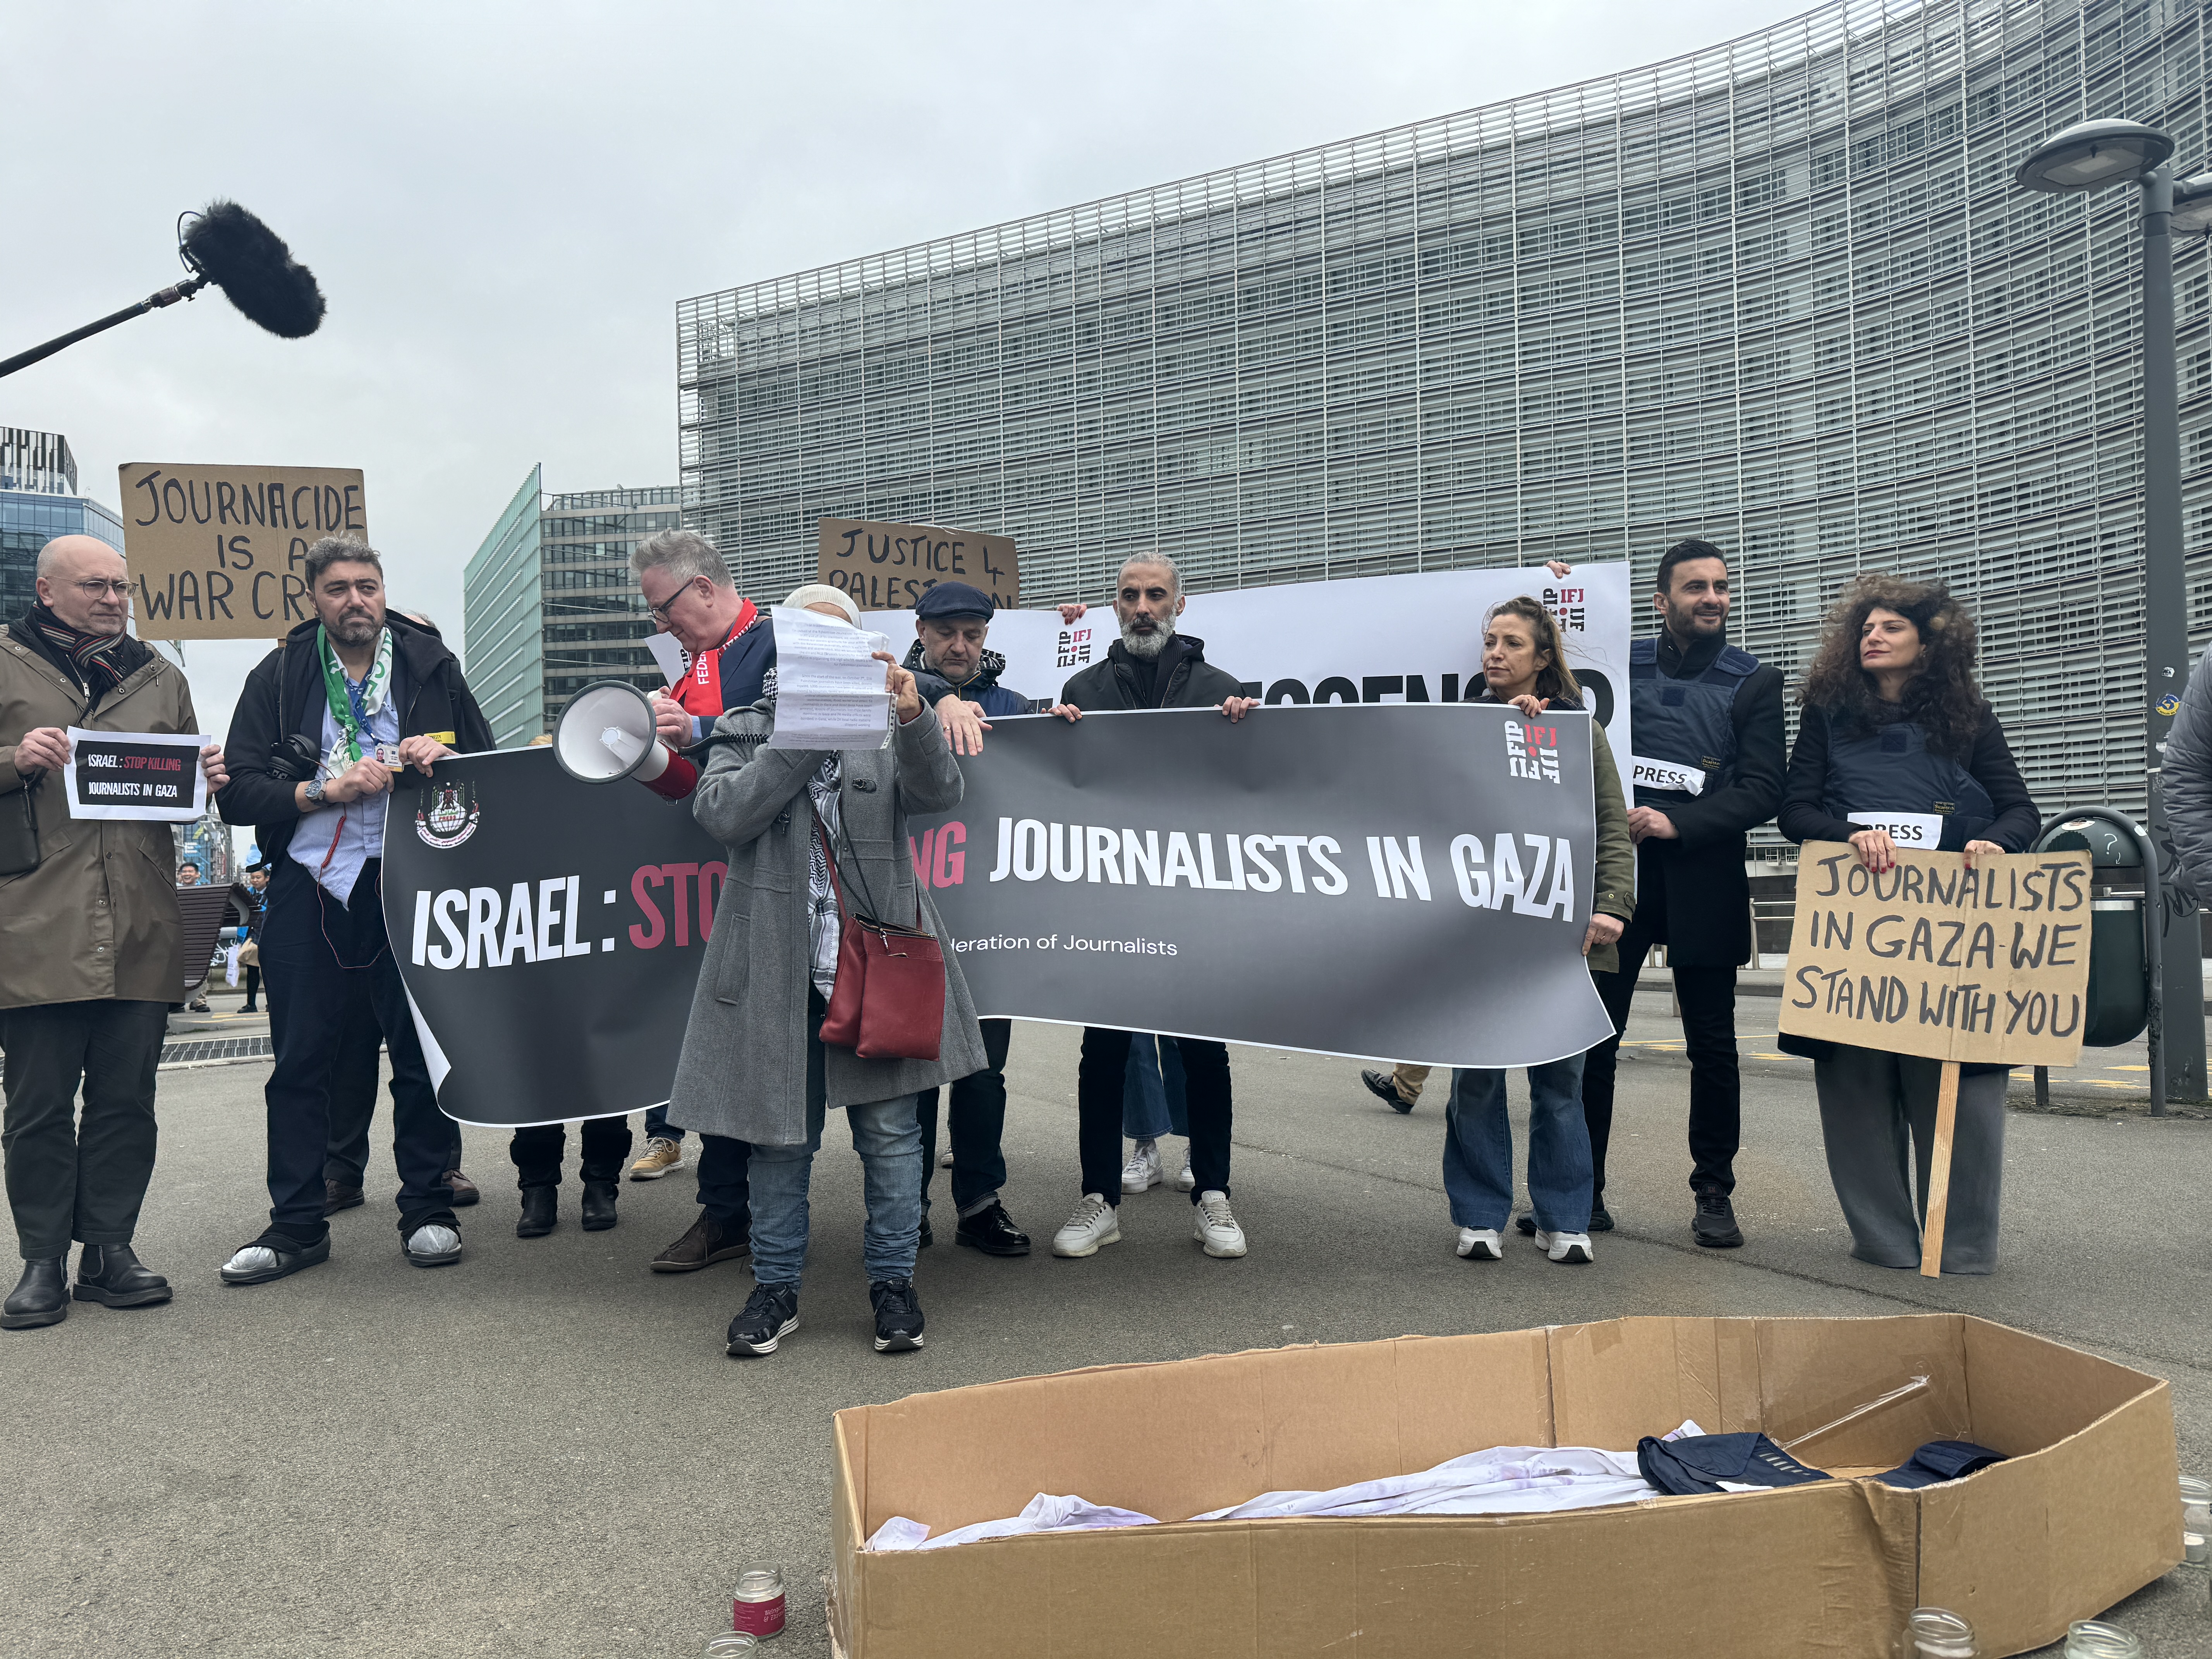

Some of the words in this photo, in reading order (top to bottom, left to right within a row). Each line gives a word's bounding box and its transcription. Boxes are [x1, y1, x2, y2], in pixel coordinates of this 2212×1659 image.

[135, 470, 364, 532] JOURNACIDE
[217, 534, 254, 570] IS
[288, 537, 309, 571] A
[836, 527, 966, 575] JUSTICE
[982, 544, 1005, 587] 4
[140, 570, 234, 621] WAR
[1561, 588, 1584, 603] IFJ
[1058, 631, 1071, 654] FIP
[1072, 629, 1092, 642] IFJ
[1504, 721, 1527, 757] FIP
[1524, 724, 1557, 746] IFJ
[88, 754, 118, 768] ISRAEL
[124, 756, 147, 769] STOP
[148, 757, 181, 771] KILLING
[1633, 765, 1687, 784] PRESS
[89, 782, 140, 796] JOURNALISTS
[143, 784, 152, 796] IN
[155, 785, 177, 798] GAZA
[412, 875, 591, 970] ISRAEL
[629, 862, 728, 949] STO
[990, 817, 1348, 895] JOURNALISTS
[1366, 836, 1432, 901] IN
[1450, 833, 1574, 922] GAZA
[1815, 853, 2087, 912] JOURNALISTS
[1036, 934, 1058, 949] of
[1063, 935, 1178, 956] Journalists
[1810, 910, 1853, 950] IN
[1791, 965, 1909, 1024] STAND
[1919, 981, 1996, 1034] WITH
[2005, 989, 2080, 1037] YOU
